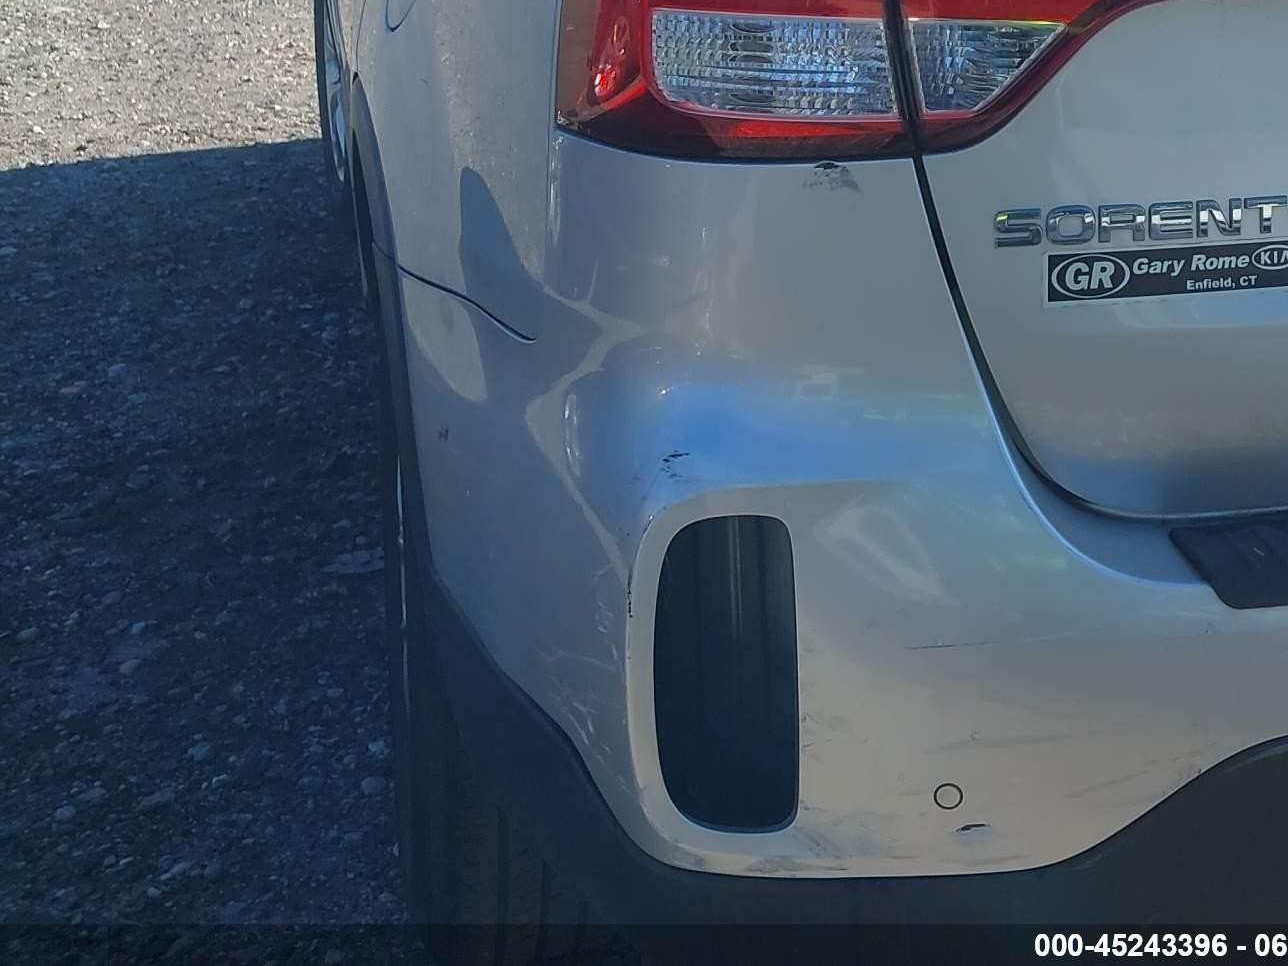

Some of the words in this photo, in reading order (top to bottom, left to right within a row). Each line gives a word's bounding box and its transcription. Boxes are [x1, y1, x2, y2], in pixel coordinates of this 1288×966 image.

[1064, 261, 1115, 292] GR
[1132, 257, 1185, 277] Gary
[1190, 254, 1250, 271] Rome
[1186, 277, 1236, 290] Enfield,
[1239, 275, 1258, 286] CT
